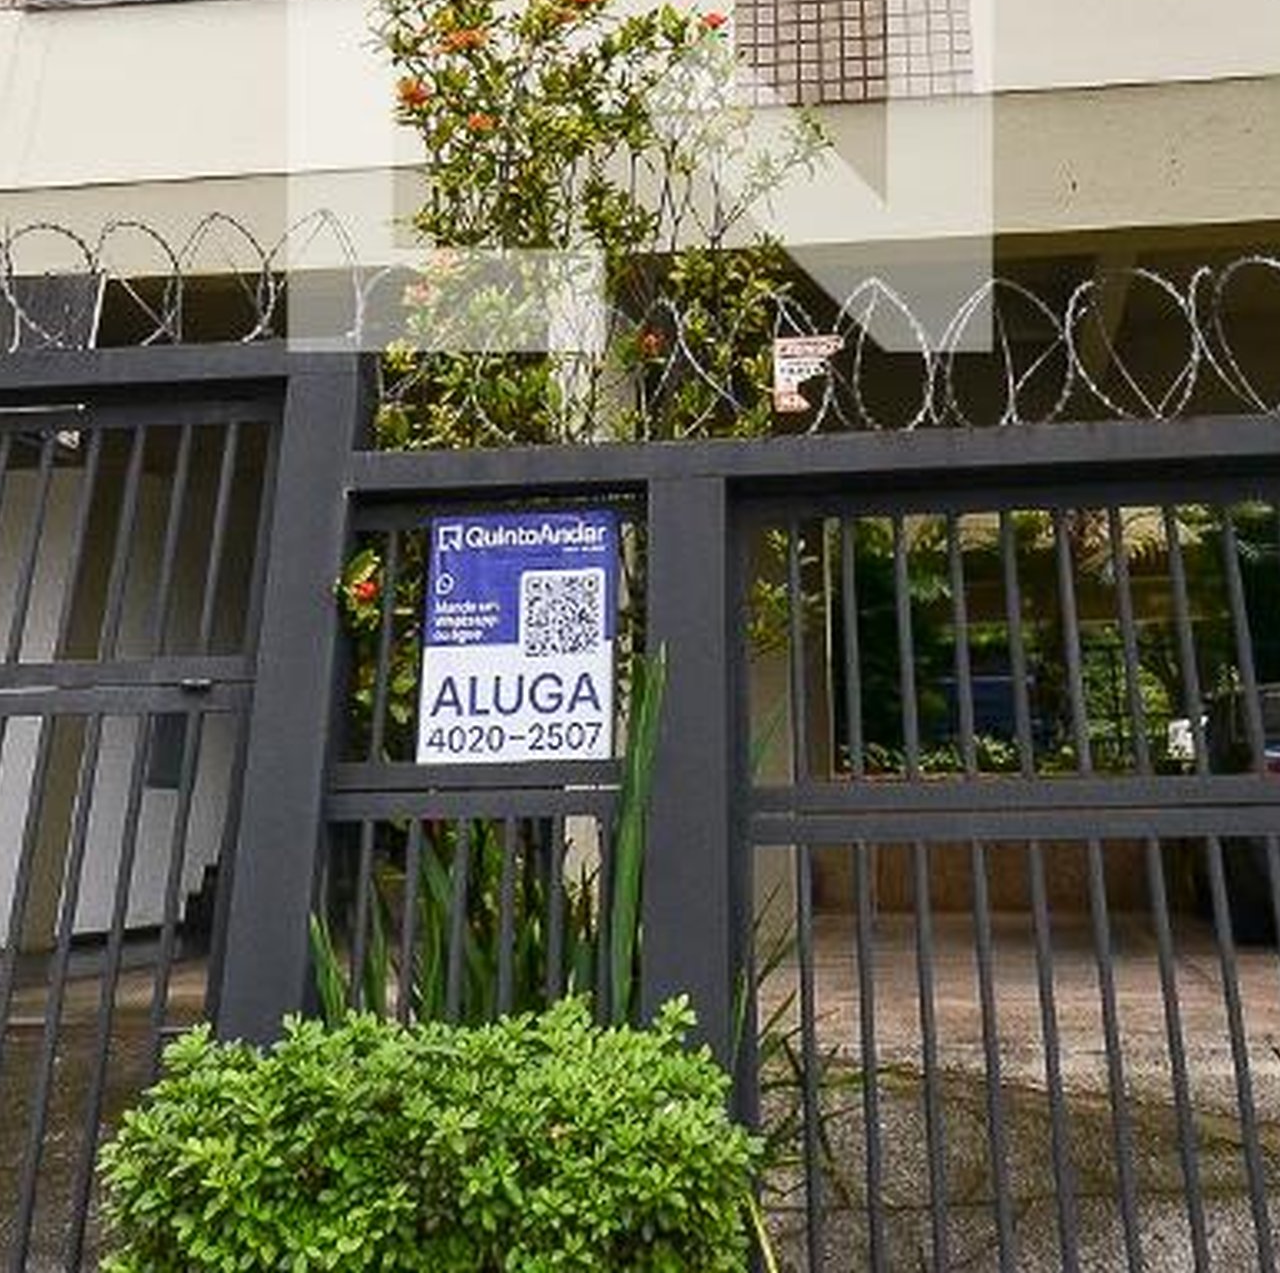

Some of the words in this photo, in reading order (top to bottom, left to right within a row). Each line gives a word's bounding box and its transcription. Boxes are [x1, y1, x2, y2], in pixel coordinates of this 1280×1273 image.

[465, 523, 607, 548] QuintoAndar
[429, 672, 602, 718] ALUGA
[426, 722, 603, 753] 4020-2507
